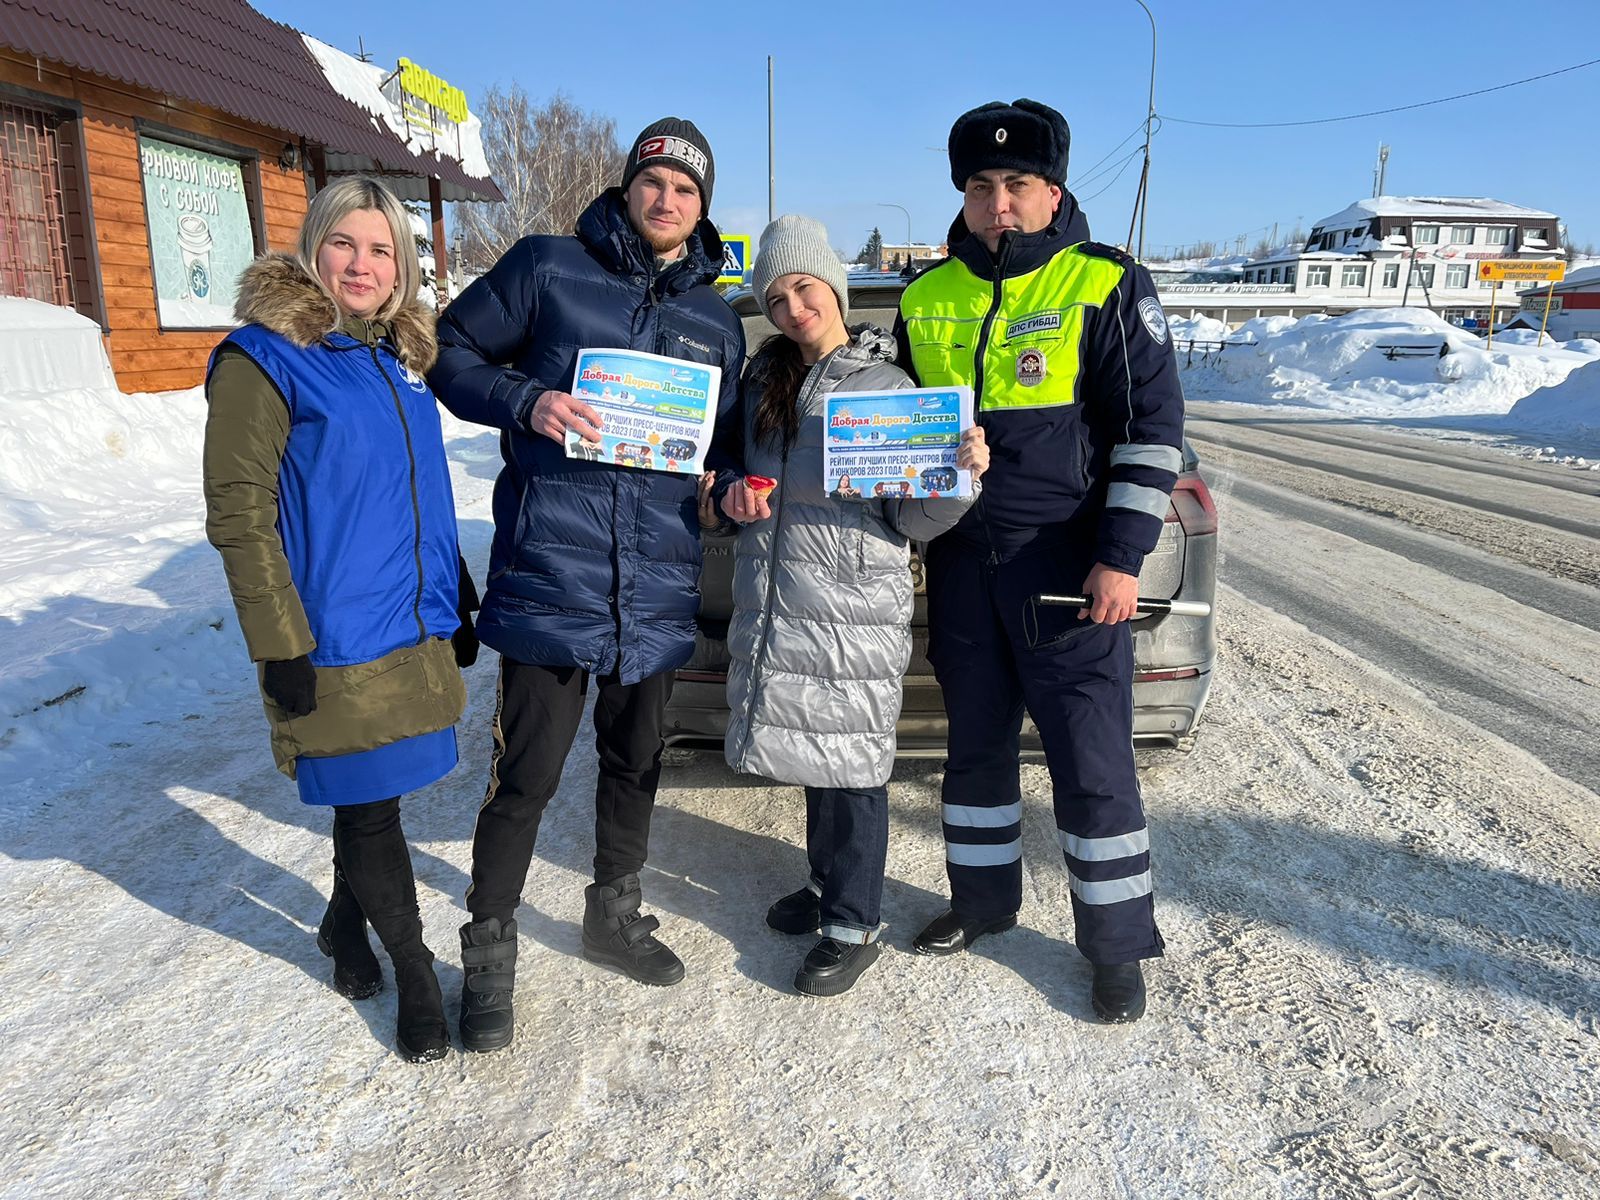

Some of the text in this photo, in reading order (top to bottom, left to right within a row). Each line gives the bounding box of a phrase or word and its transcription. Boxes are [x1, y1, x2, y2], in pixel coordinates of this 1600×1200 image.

[399, 57, 468, 123] авокадо
[663, 138, 705, 175] DIESEL
[203, 164, 239, 193] КОФЕ
[160, 183, 220, 216] С СОБОЙ
[1008, 315, 1058, 336] ДПС ГИБДД
[581, 370, 622, 382] Добрая
[624, 374, 661, 389] Дорога
[662, 382, 705, 398] Детства
[604, 412, 633, 426] ЛУЧШИХ
[633, 418, 685, 435] ПРЕСС-ЦЕНТРОВ
[685, 427, 701, 439] ЮИД
[611, 424, 628, 436] 2023
[629, 428, 647, 440] ГОДА
[831, 413, 957, 428] Добрая Дорога Детства
[830, 456, 857, 467] РЕЙТИНГ
[858, 456, 887, 466] ЛУЧШИХ
[888, 453, 940, 465] ПРЕСС-ЦЕНТРОВ
[867, 466, 884, 476] 2023
[884, 465, 902, 475] ГОДА
